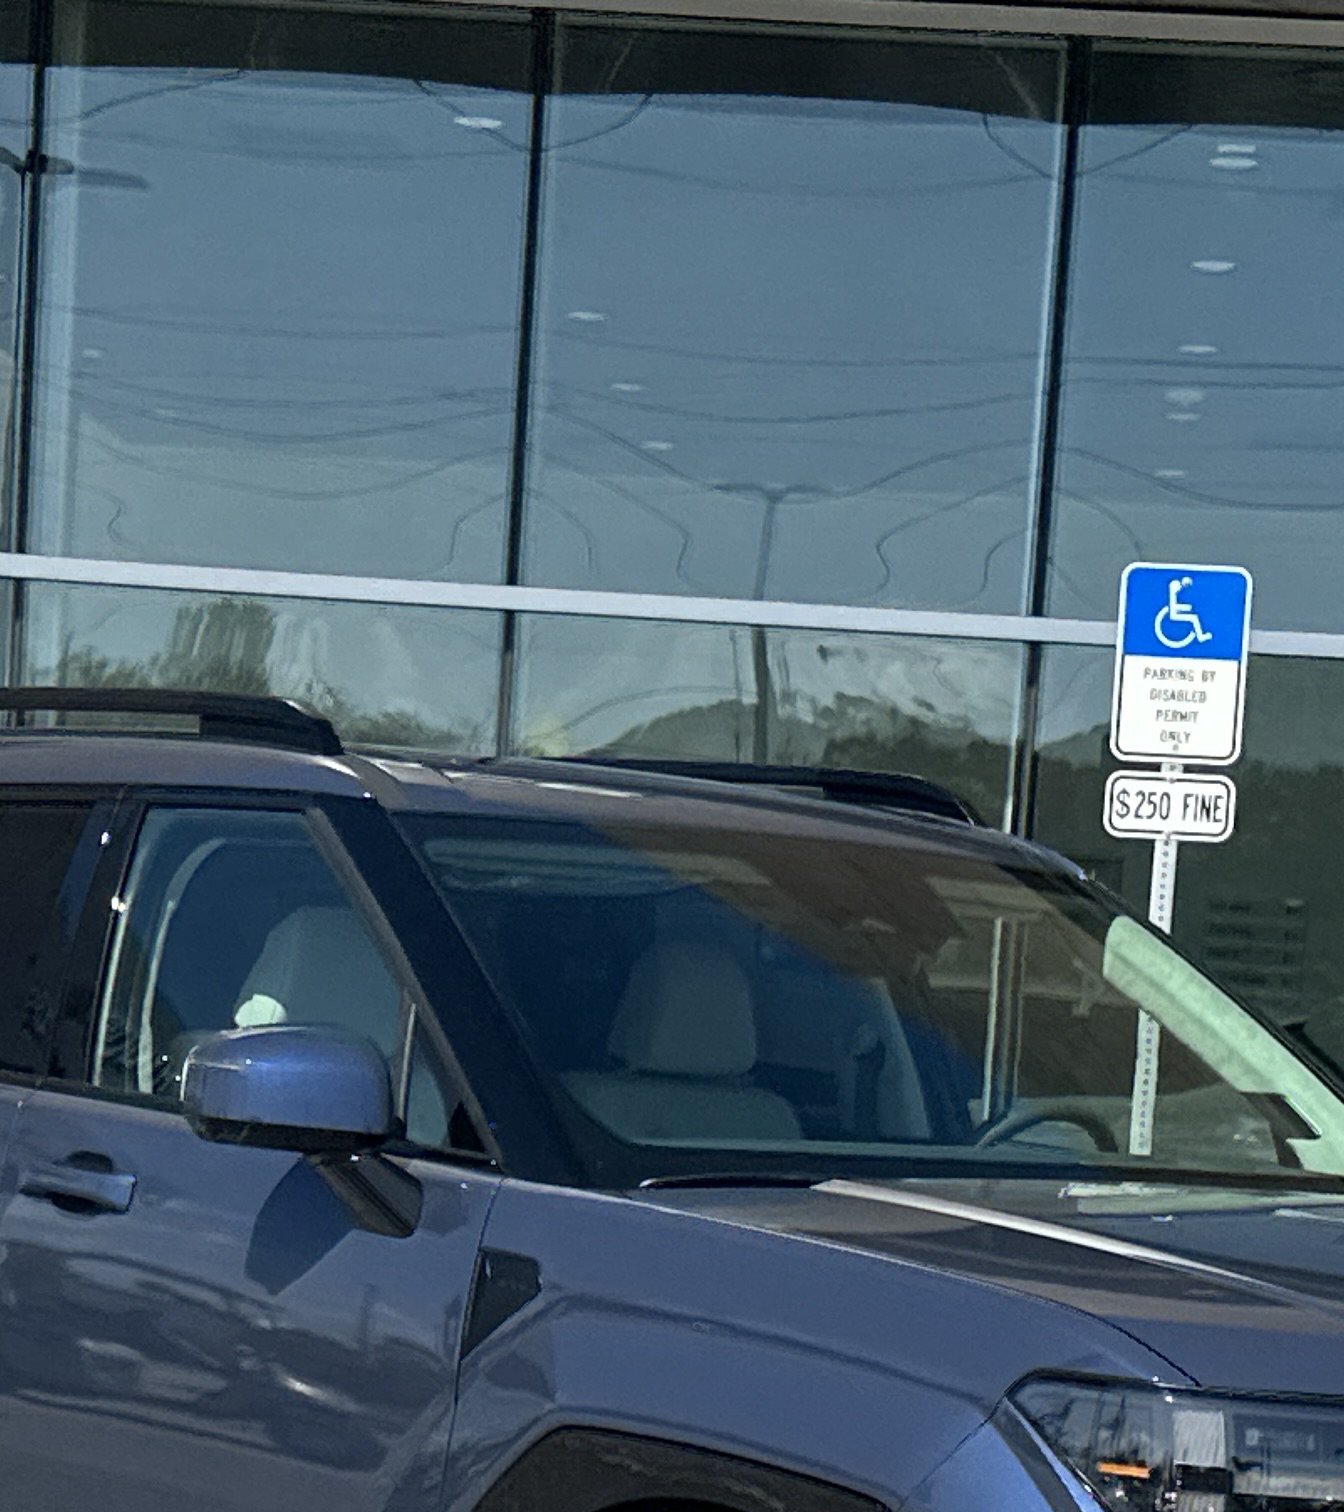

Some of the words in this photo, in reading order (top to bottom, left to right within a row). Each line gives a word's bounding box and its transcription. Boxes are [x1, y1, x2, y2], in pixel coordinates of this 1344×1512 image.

[1143, 666, 1195, 682] PARKING
[1201, 669, 1216, 683] BY
[1149, 687, 1207, 704] DISABLED
[1155, 709, 1199, 723] PERMIT
[1159, 729, 1191, 744] ONLY
[1115, 787, 1172, 821] $250
[1182, 792, 1225, 823] FINE
